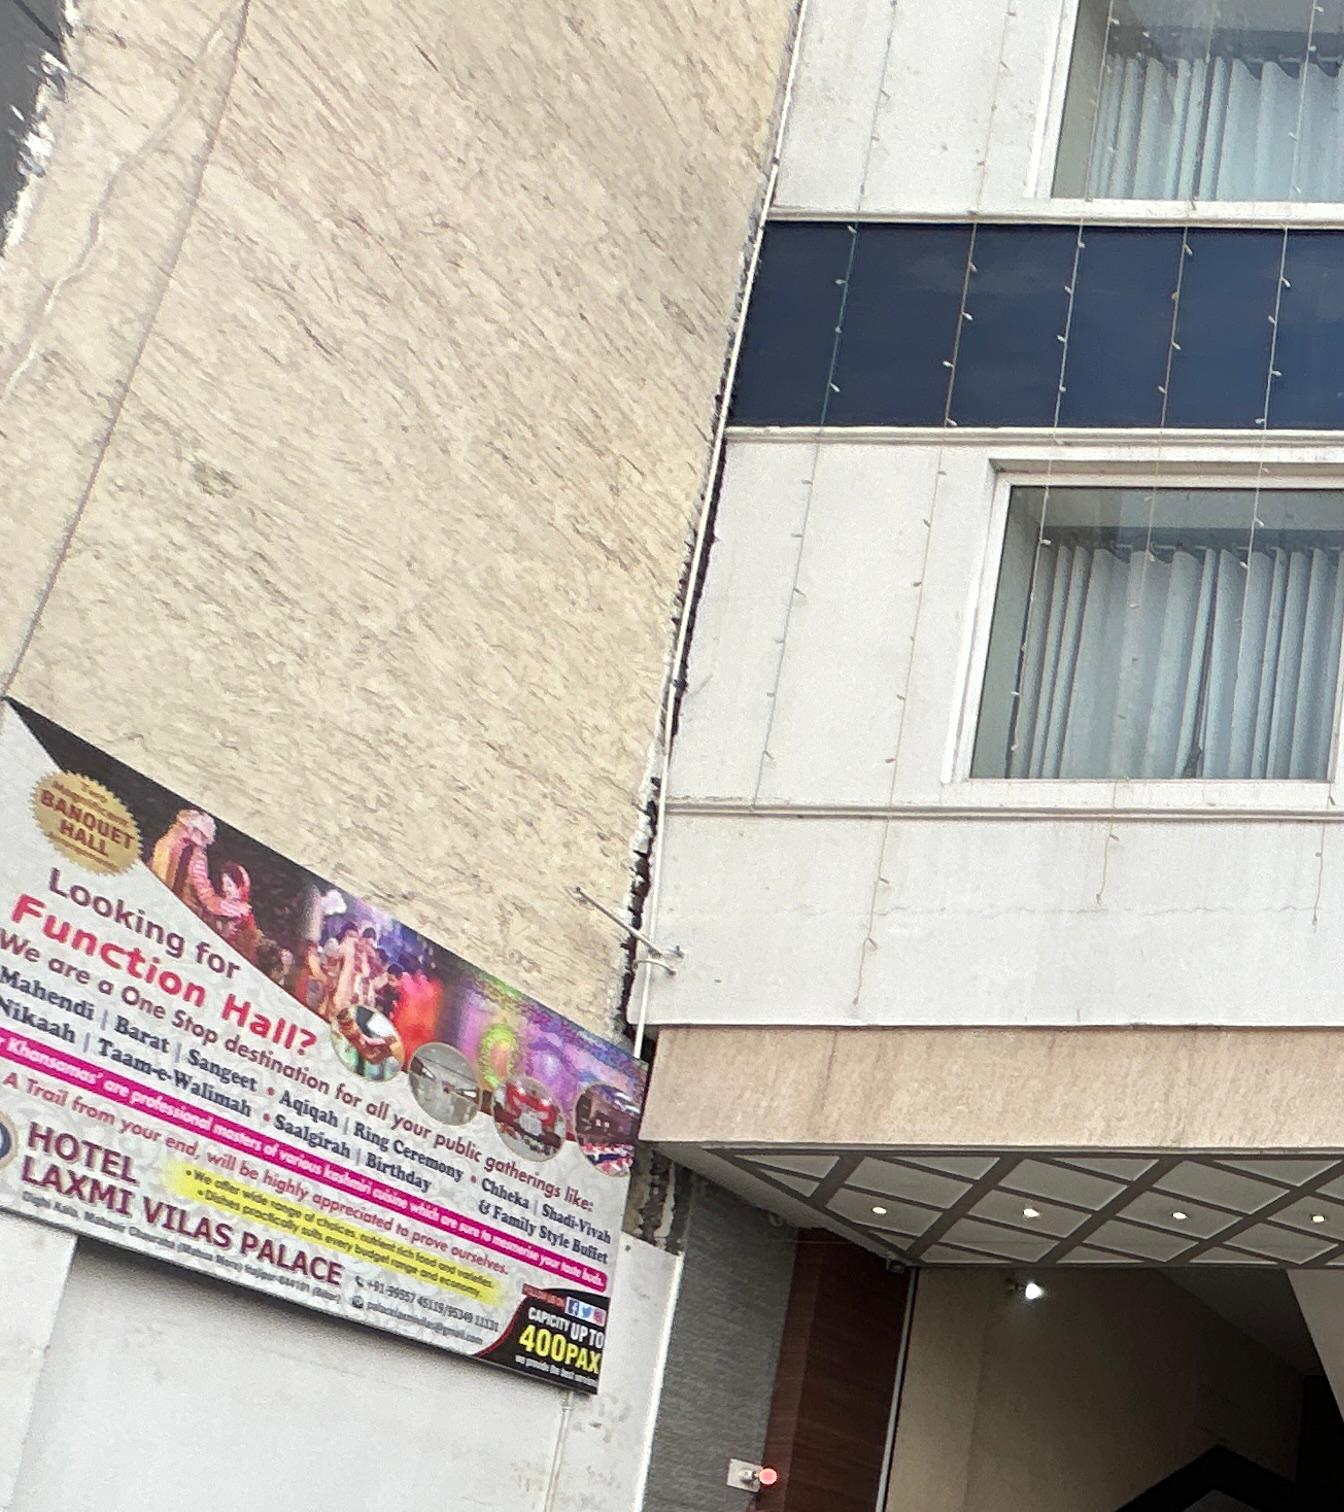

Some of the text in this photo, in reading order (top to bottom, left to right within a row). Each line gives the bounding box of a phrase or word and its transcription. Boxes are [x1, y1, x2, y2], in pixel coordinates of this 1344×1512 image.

[41, 789, 135, 849] BANQUET
[60, 819, 109, 858] HALL
[10, 893, 318, 1055] Function Hall?
[49, 867, 241, 980] Looking for
[0, 928, 594, 1213] We are a One Stop destination for all your public gatherings like:
[0, 965, 612, 1244] Mahendi Barat Sangeet Aqiqah Ring Ceremony Chheka Shadi-Vivah
[103, 1080, 130, 1098] are
[130, 1089, 214, 1132] professional
[2, 1072, 509, 1275] A Trail from your end, will be highly appreciated to prove ourselves.
[28, 1121, 140, 1187] HOTEL
[98, 1037, 252, 1117] Taam-e-Walimah
[274, 1113, 351, 1159] Saalgirah
[366, 1152, 432, 1194] Birthday
[479, 1199, 490, 1215] &
[493, 1205, 537, 1237] Family
[539, 1225, 570, 1249] Style
[572, 1239, 609, 1264] Buffet
[20, 1154, 136, 1219] LAXMI
[143, 1195, 234, 1250] VILAS
[240, 1230, 345, 1286] PALACE
[570, 1322, 588, 1342] UP
[588, 1329, 605, 1349] TO
